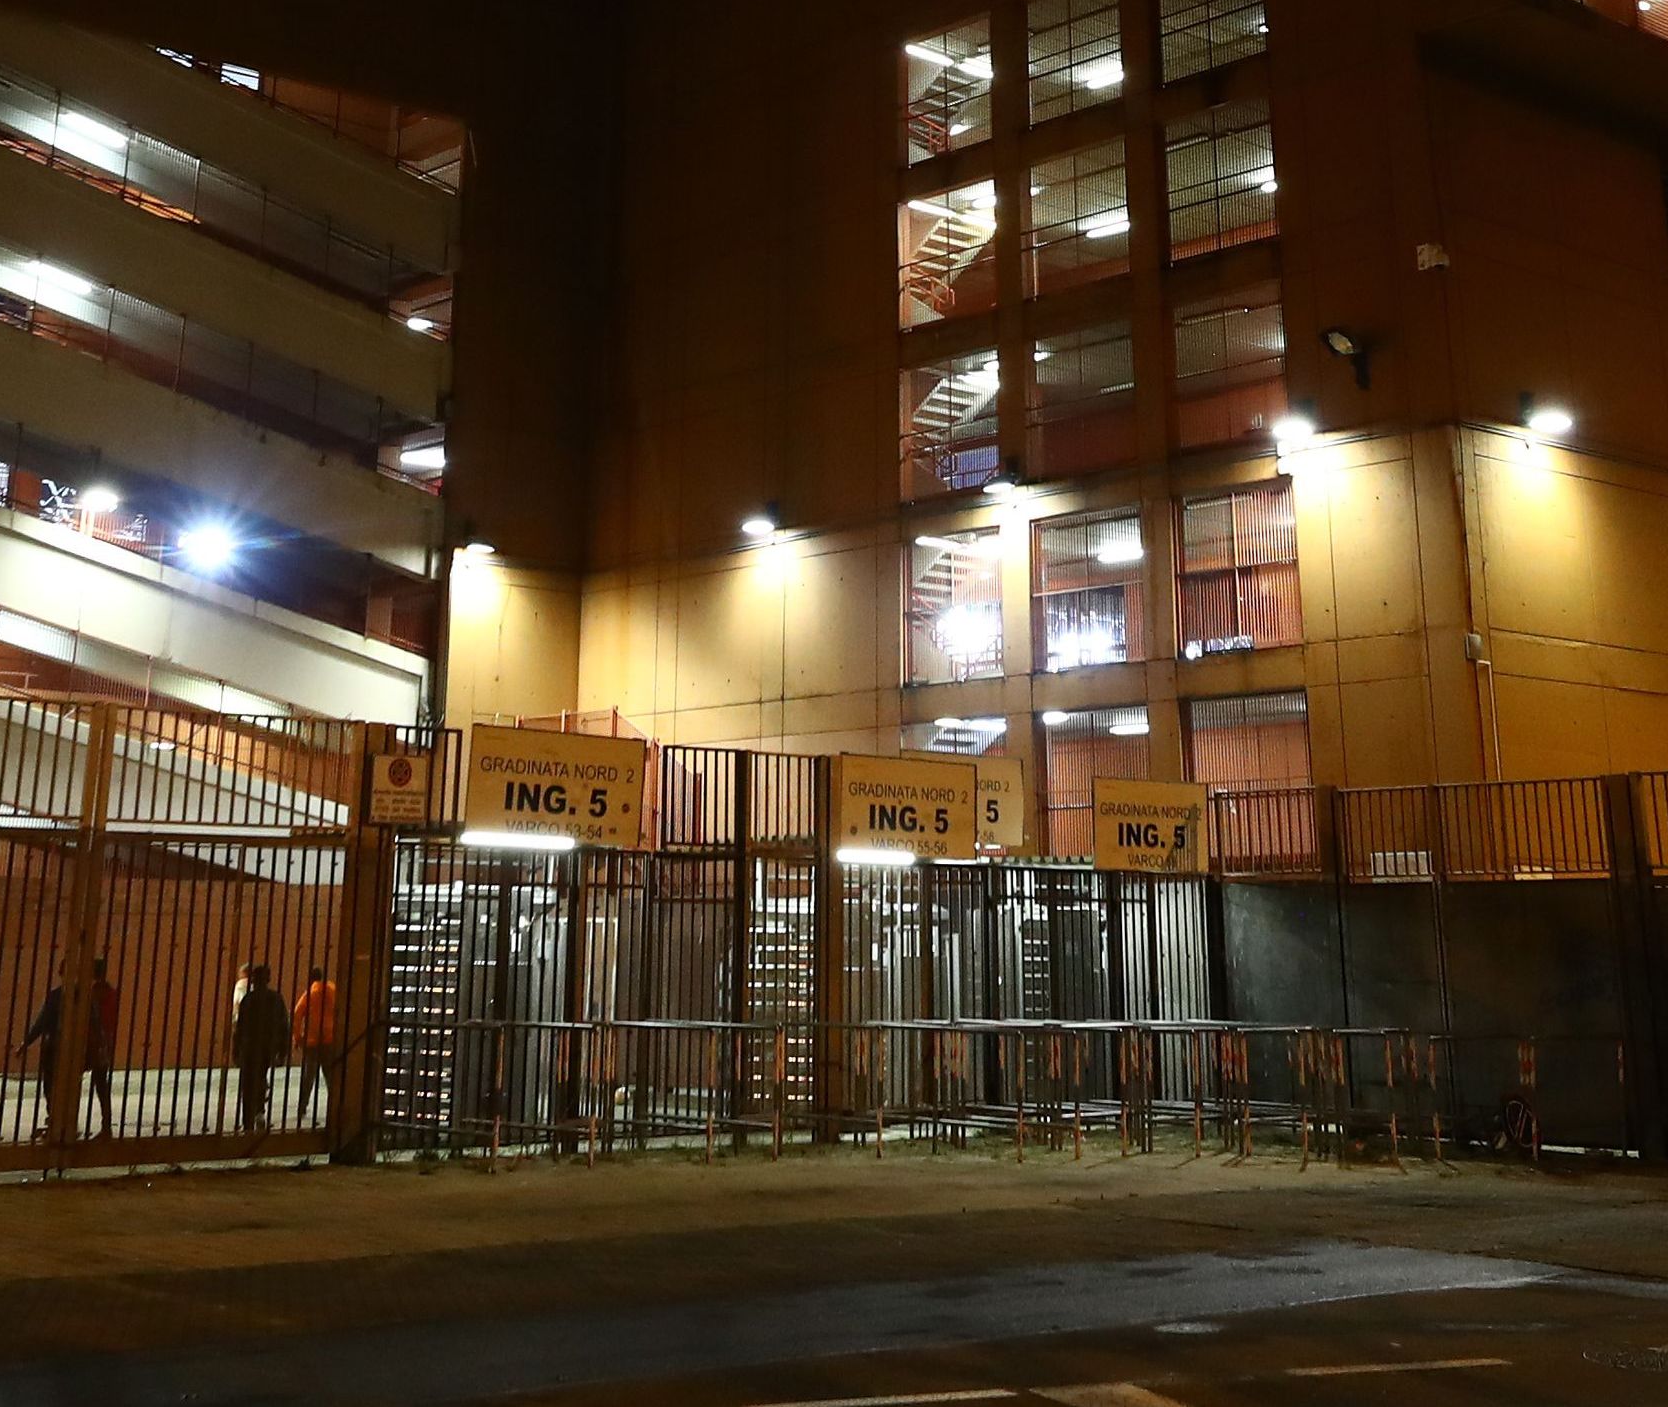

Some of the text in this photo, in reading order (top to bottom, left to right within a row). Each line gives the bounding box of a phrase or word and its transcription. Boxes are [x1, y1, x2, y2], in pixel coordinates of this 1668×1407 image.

[481, 756, 635, 783] GRADINATA NORD 2
[848, 782, 968, 804] GRADINATA NORD 2
[976, 779, 1010, 792] ORD 2
[504, 782, 608, 817] ING. 5
[986, 799, 999, 823] 5
[1100, 801, 1159, 818] GRADINATA
[1162, 806, 1190, 820] NORD
[869, 804, 948, 833] ING. 5
[1118, 822, 1185, 849] ING. 5
[1128, 853, 1164, 868] VARCO
